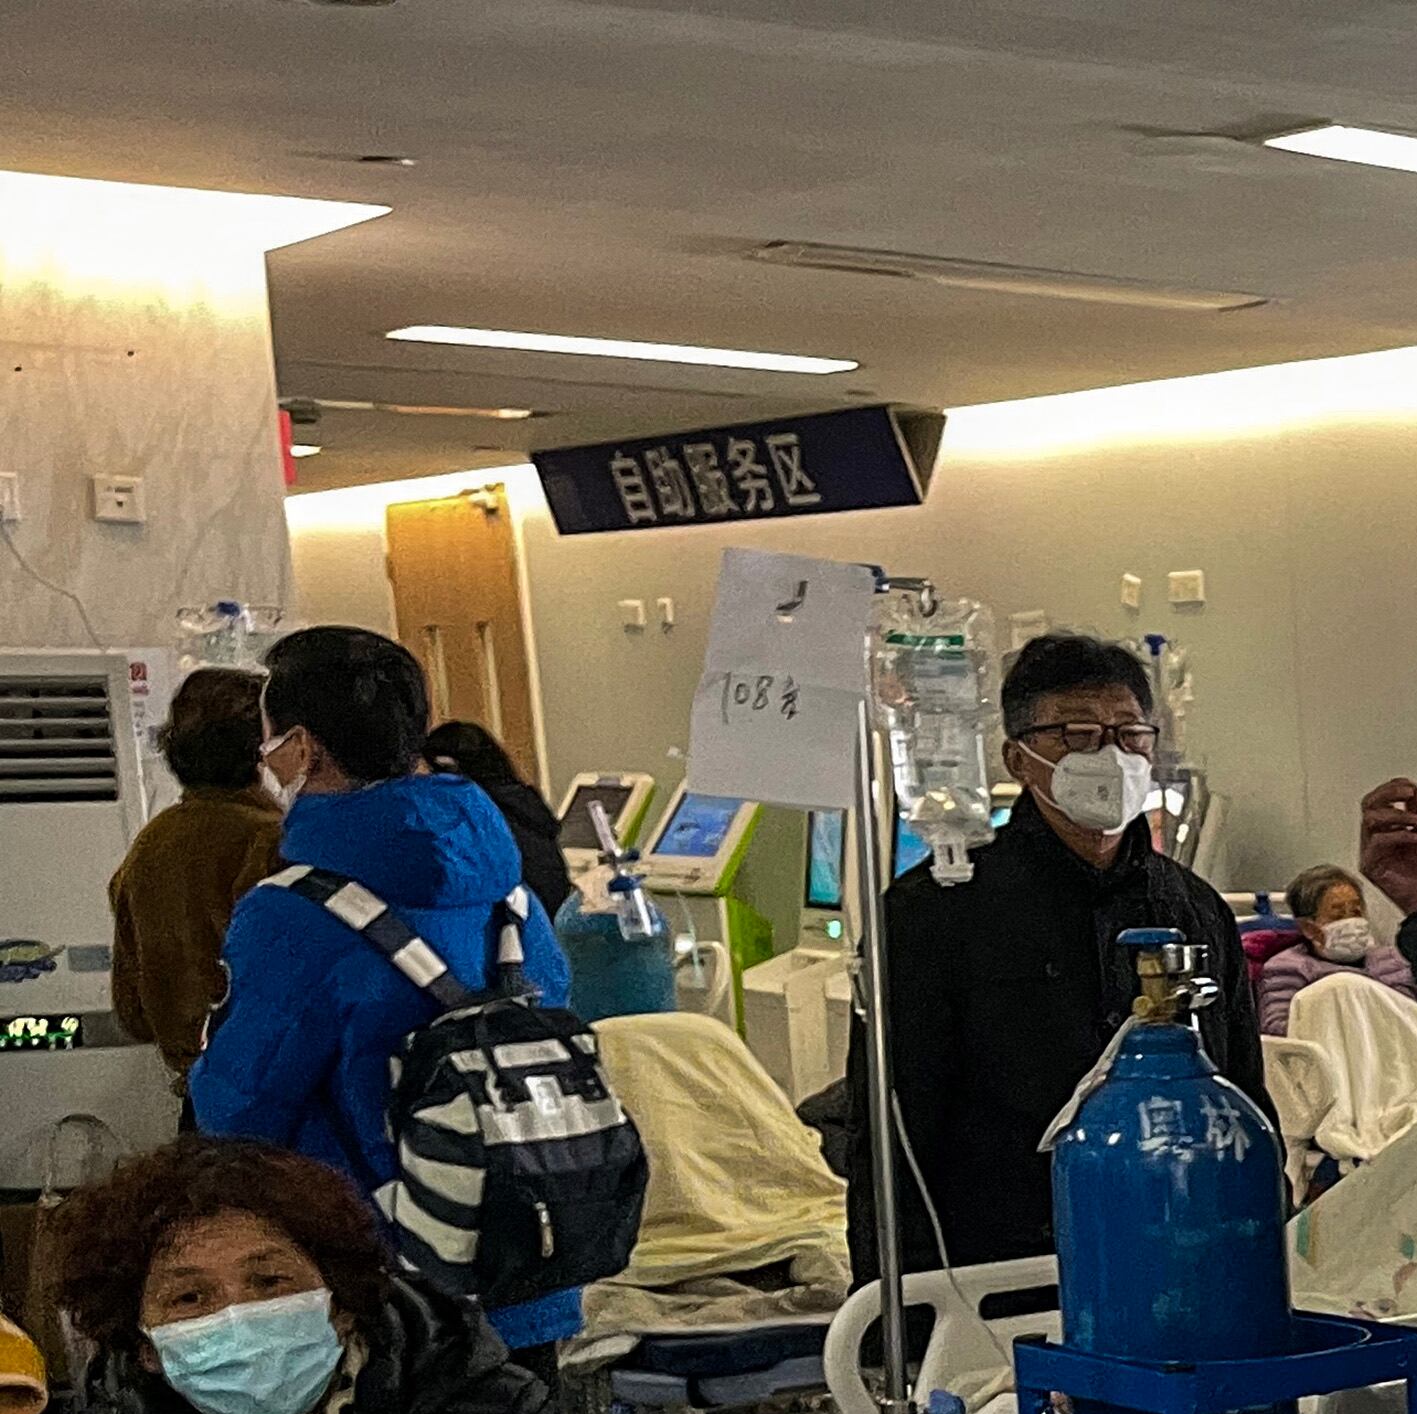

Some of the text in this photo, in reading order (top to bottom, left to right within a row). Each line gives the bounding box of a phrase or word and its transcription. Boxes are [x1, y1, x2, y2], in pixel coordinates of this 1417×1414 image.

[608, 432, 822, 523] 自助服务区
